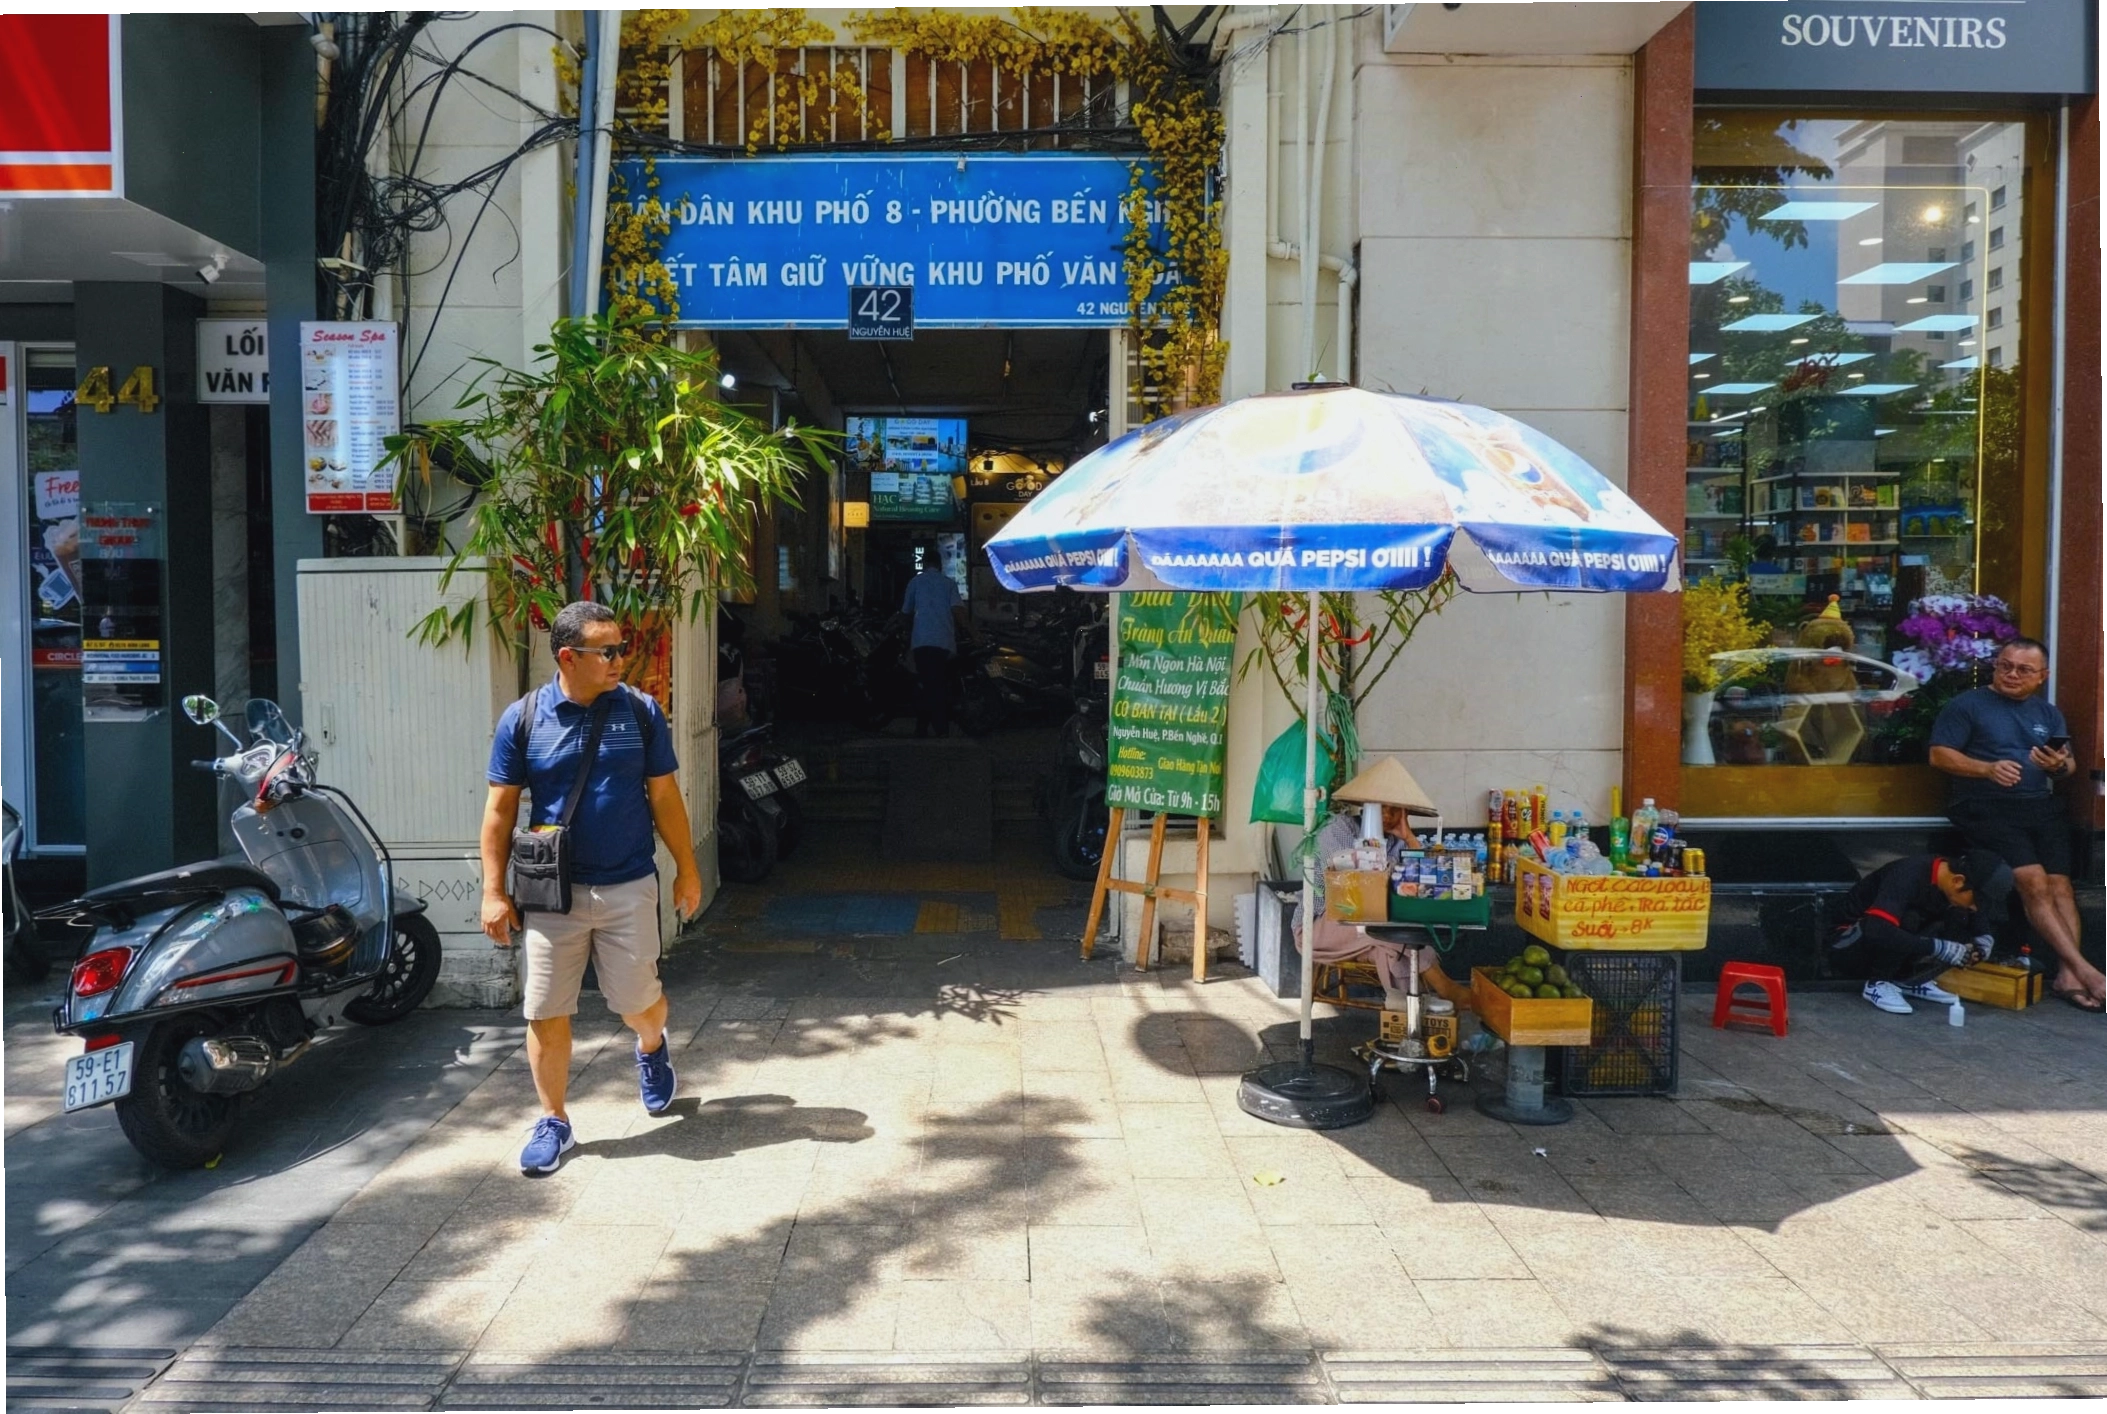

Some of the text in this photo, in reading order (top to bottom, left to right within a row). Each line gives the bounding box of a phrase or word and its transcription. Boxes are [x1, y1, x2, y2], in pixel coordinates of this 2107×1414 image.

[1782, 14, 2006, 49] SOUVENIRS
[681, 194, 734, 225] DÂN
[748, 200, 802, 225] KHU
[815, 190, 873, 224] PHỐ
[885, 200, 902, 224] 8
[931, 190, 1041, 224] PHƯỜNG
[1052, 187, 1106, 224] BẾN
[709, 256, 767, 286] TÂM
[781, 254, 826, 286] GIỮ
[842, 254, 915, 286] VỮNG
[929, 261, 983, 286] KHU
[997, 251, 1053, 286] PHỐ
[1063, 255, 1117, 286] VĂN
[858, 289, 901, 321] 42
[1076, 302, 1095, 315] 42
[226, 327, 264, 356] LỐI
[312, 329, 386, 344] Season Spa
[852, 325, 910, 338] NGUYỄN HUỆ
[74, 366, 159, 413] 44
[206, 368, 252, 393] VĂN
[45, 476, 79, 498] Free
[915, 547, 925, 575] EYE
[1045, 552, 1067, 568] QUÁ
[1066, 549, 1098, 566] PEPSI
[1248, 547, 1296, 567] QUÁ
[1302, 549, 1365, 568] PEPSI
[1550, 549, 1583, 567] QUÁ
[1585, 553, 1625, 571] PEPSI
[1121, 616, 1164, 649] Tràng
[1128, 653, 1227, 674] Món Ngon Hà Nội
[1117, 675, 1229, 699] Chuẩn Hương Vị Bắc
[1115, 696, 1130, 717] CÓ
[1159, 704, 1178, 725] TẠI
[1211, 706, 1219, 723] 2
[1113, 725, 1140, 740] Nguyễn
[1118, 746, 1147, 760] Hotline:
[1158, 757, 1174, 770] Giao
[1176, 758, 1196, 775] Hàng
[1107, 784, 1122, 801] Giờ
[1124, 785, 1141, 803] Mở
[1143, 787, 1165, 806] Cửa:
[1167, 789, 1179, 808] Từ
[1180, 791, 1193, 809] 9h
[1201, 793, 1220, 812] 15h
[1591, 895, 1629, 918] phê
[1424, 1018, 1449, 1027] TOYS
[75, 1049, 120, 1080] 59-E1
[67, 1070, 127, 1107] 811.57
